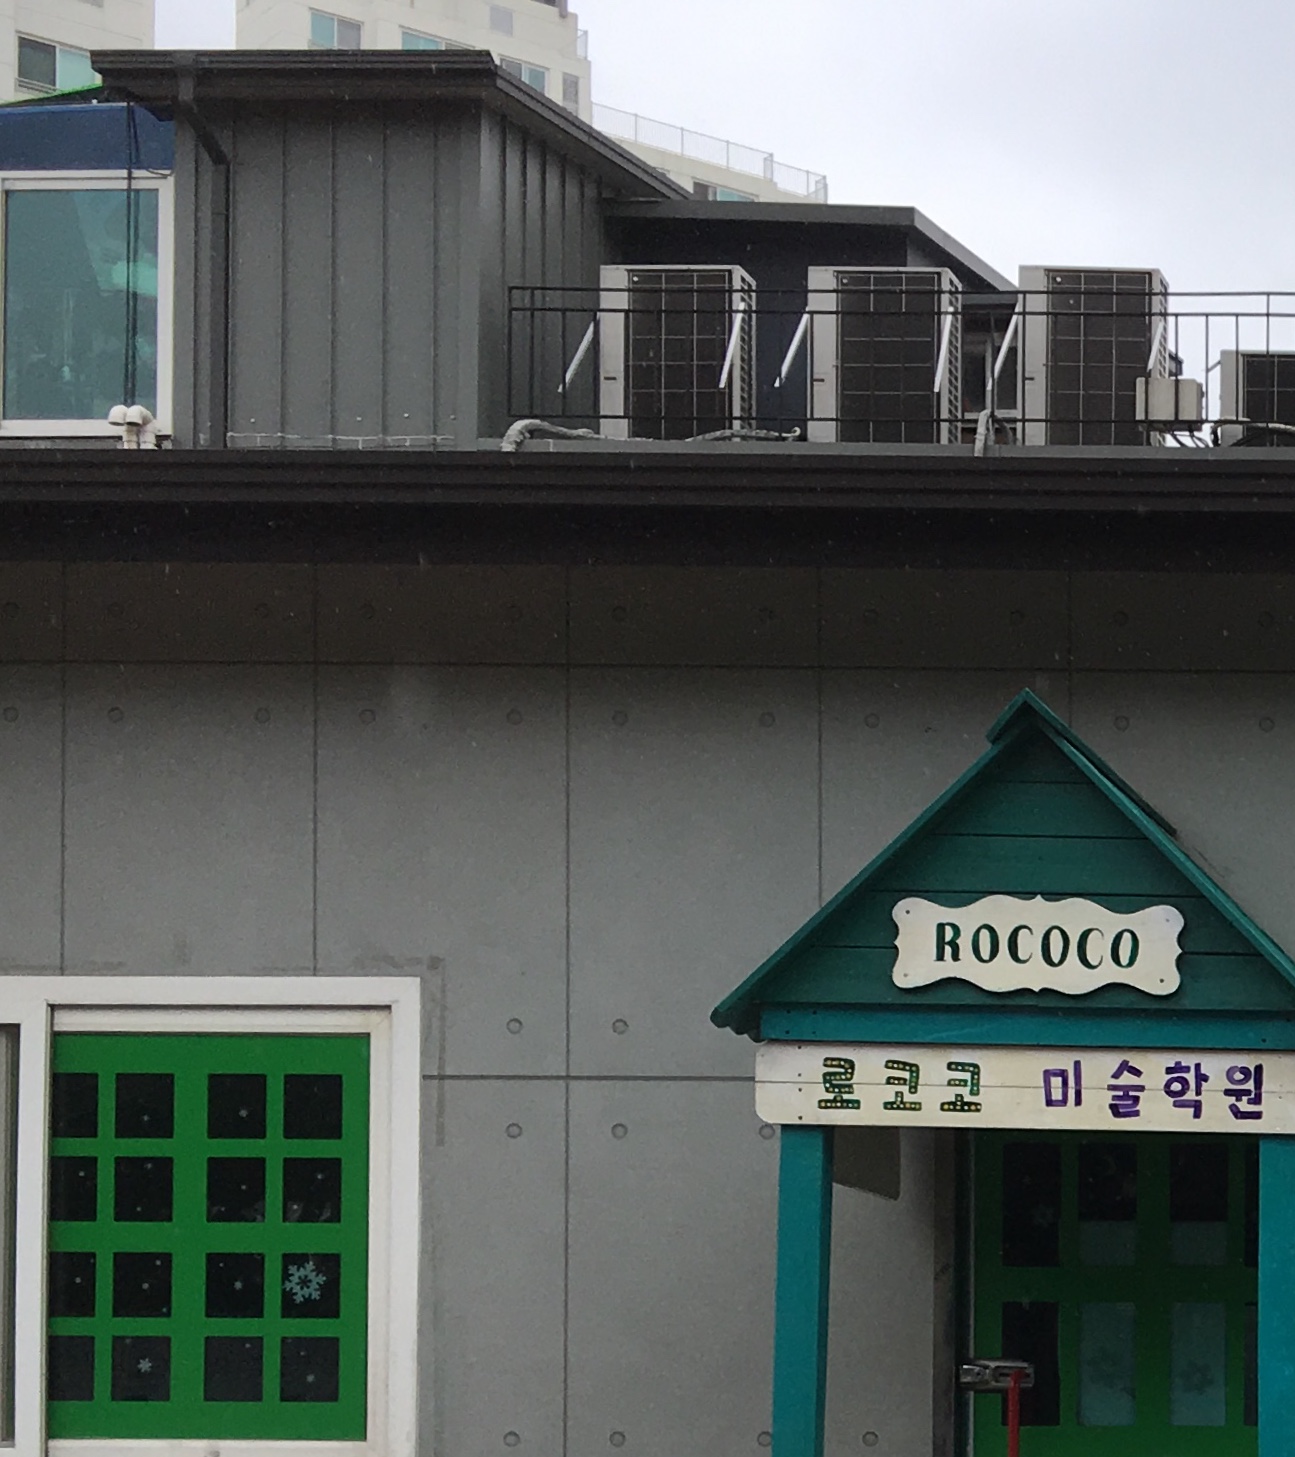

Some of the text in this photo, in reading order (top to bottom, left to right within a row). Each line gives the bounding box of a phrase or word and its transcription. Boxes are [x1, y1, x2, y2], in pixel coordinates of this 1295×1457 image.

[934, 921, 1140, 970] ROCOCO
[817, 1056, 1264, 1121] 로코코 미술학원
